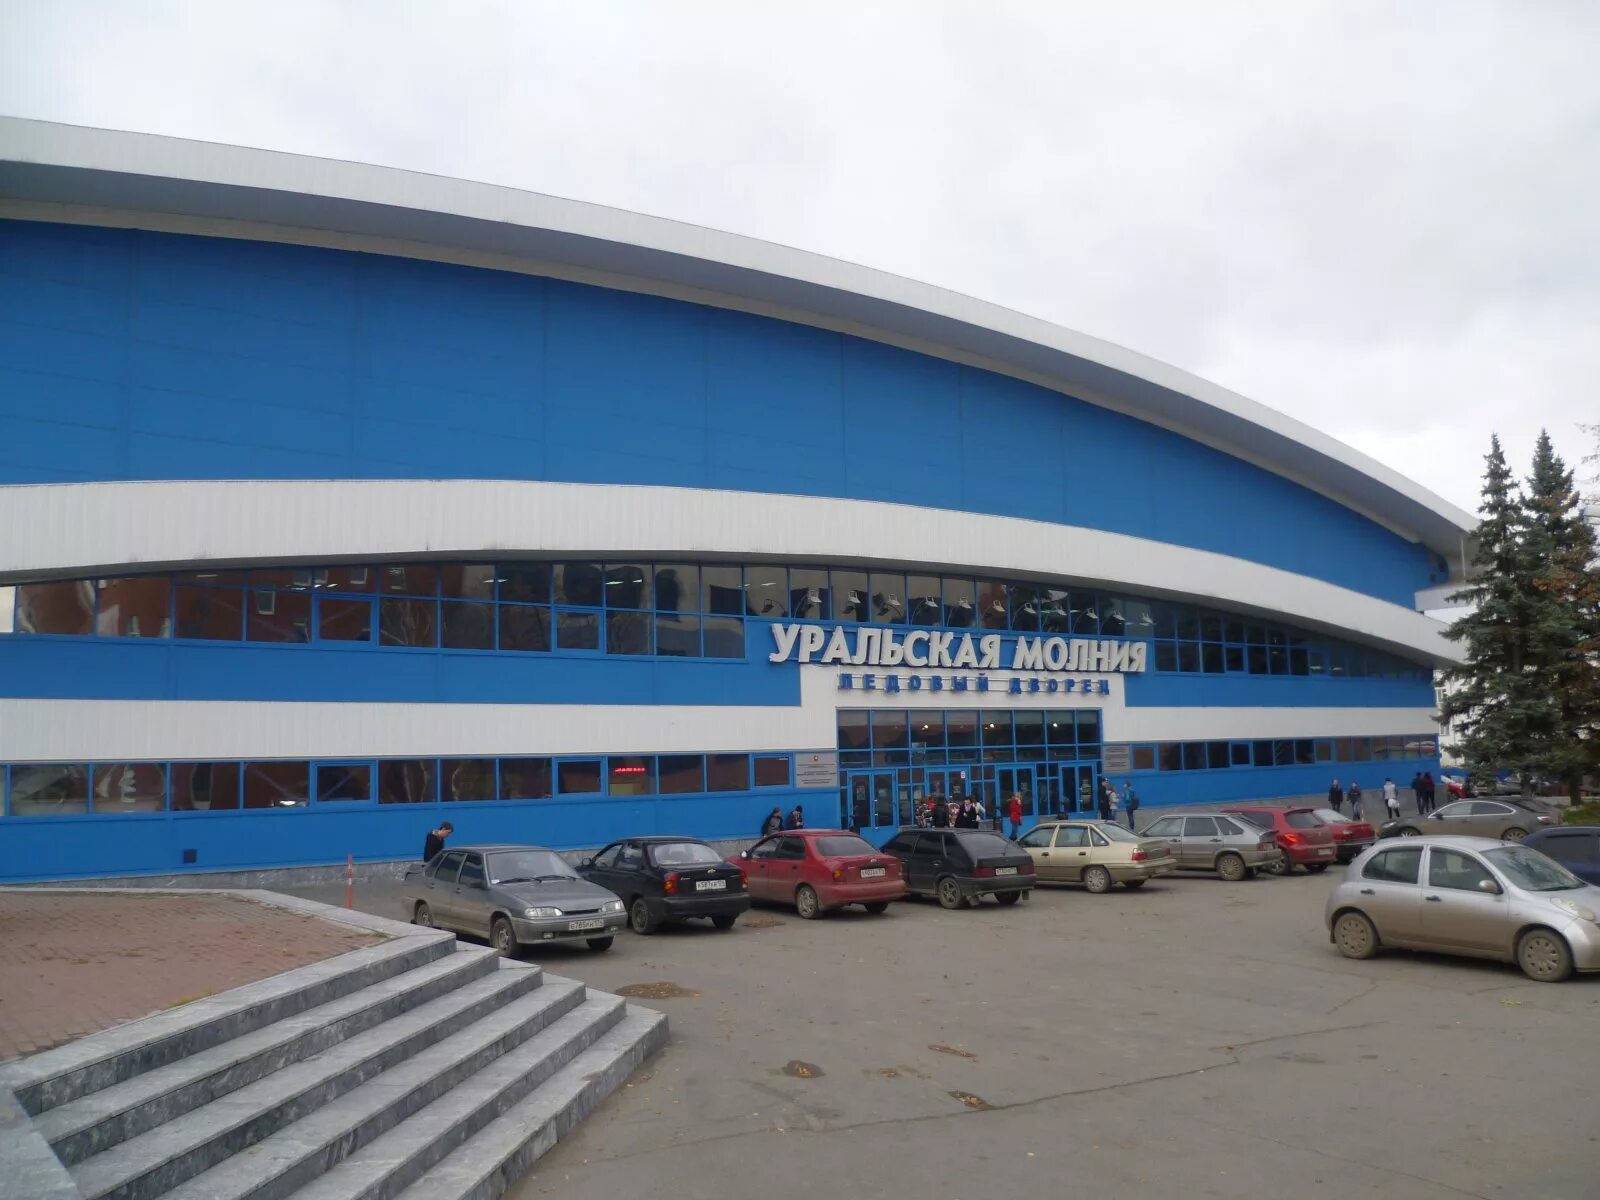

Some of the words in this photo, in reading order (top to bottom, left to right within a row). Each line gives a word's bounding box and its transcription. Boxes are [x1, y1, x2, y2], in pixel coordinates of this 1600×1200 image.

[769, 623, 1000, 669] УРАЛЬСКАЯ
[1012, 635, 1147, 672] МОЛНИЯ
[839, 673, 989, 693] ЛЕДОВЫЙ
[1008, 677, 1110, 695] ДВОРЕЦ
